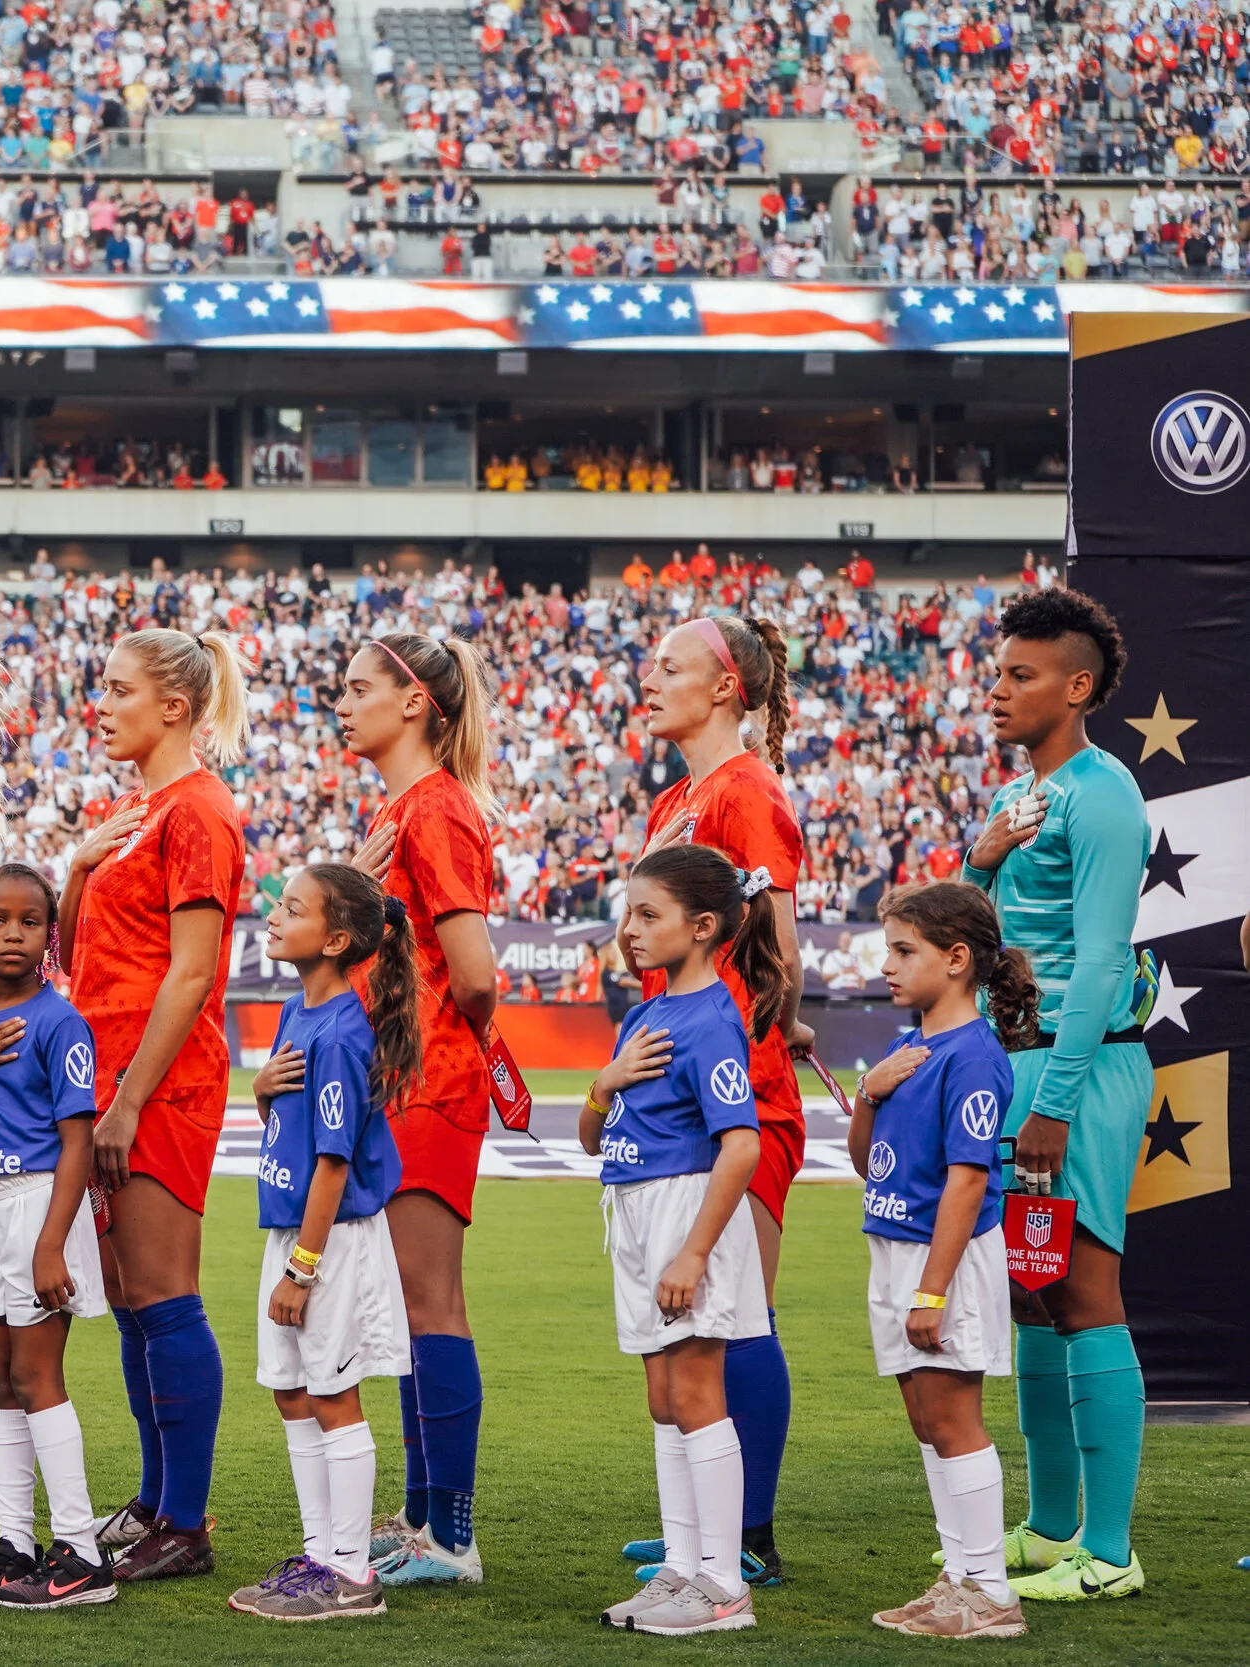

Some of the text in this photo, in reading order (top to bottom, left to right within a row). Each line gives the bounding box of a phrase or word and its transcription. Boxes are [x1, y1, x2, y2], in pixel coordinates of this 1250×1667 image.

[1157, 396, 1248, 488] VW
[497, 942, 586, 970] Allstat
[710, 1058, 749, 1105] VW
[962, 1090, 998, 1140] VW
[1028, 1214, 1050, 1229] USA
[1007, 1248, 1064, 1264] ONE NATION.
[1008, 1261, 1059, 1275] ONE TEAM.
